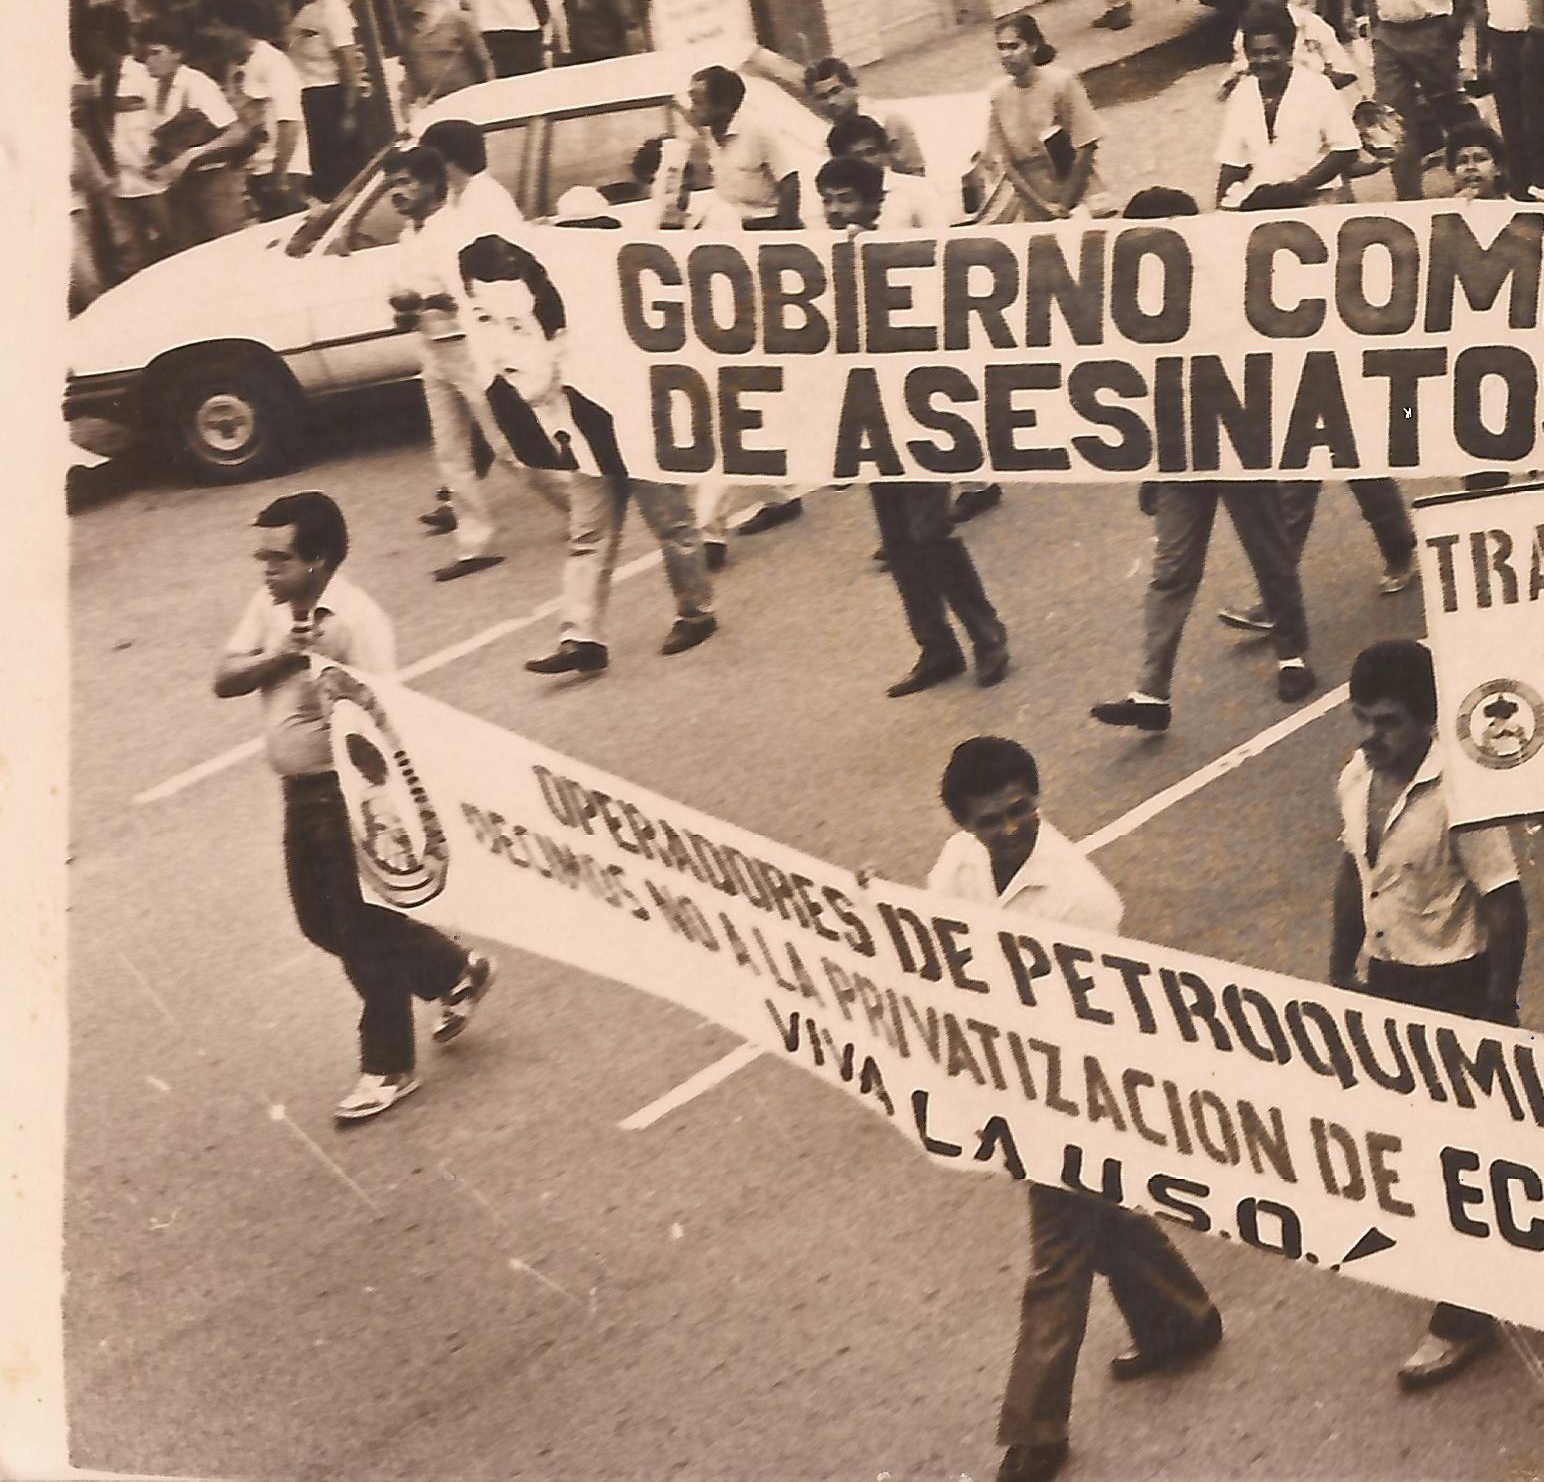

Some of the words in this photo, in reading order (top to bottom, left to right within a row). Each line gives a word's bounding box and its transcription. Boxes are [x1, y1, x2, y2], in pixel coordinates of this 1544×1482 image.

[617, 226, 1196, 356] GOBIERNO
[648, 364, 787, 477] DE
[530, 763, 876, 958] OPERADORES
[875, 901, 992, 994] DE
[644, 878, 721, 952] NO
[718, 911, 763, 977] A
[752, 926, 828, 1010] LA
[818, 952, 1299, 1185] PRIVATIZACION
[1310, 1117, 1416, 1219] DE
[763, 997, 896, 1116] VIVA
[910, 1089, 1027, 1180] LA
